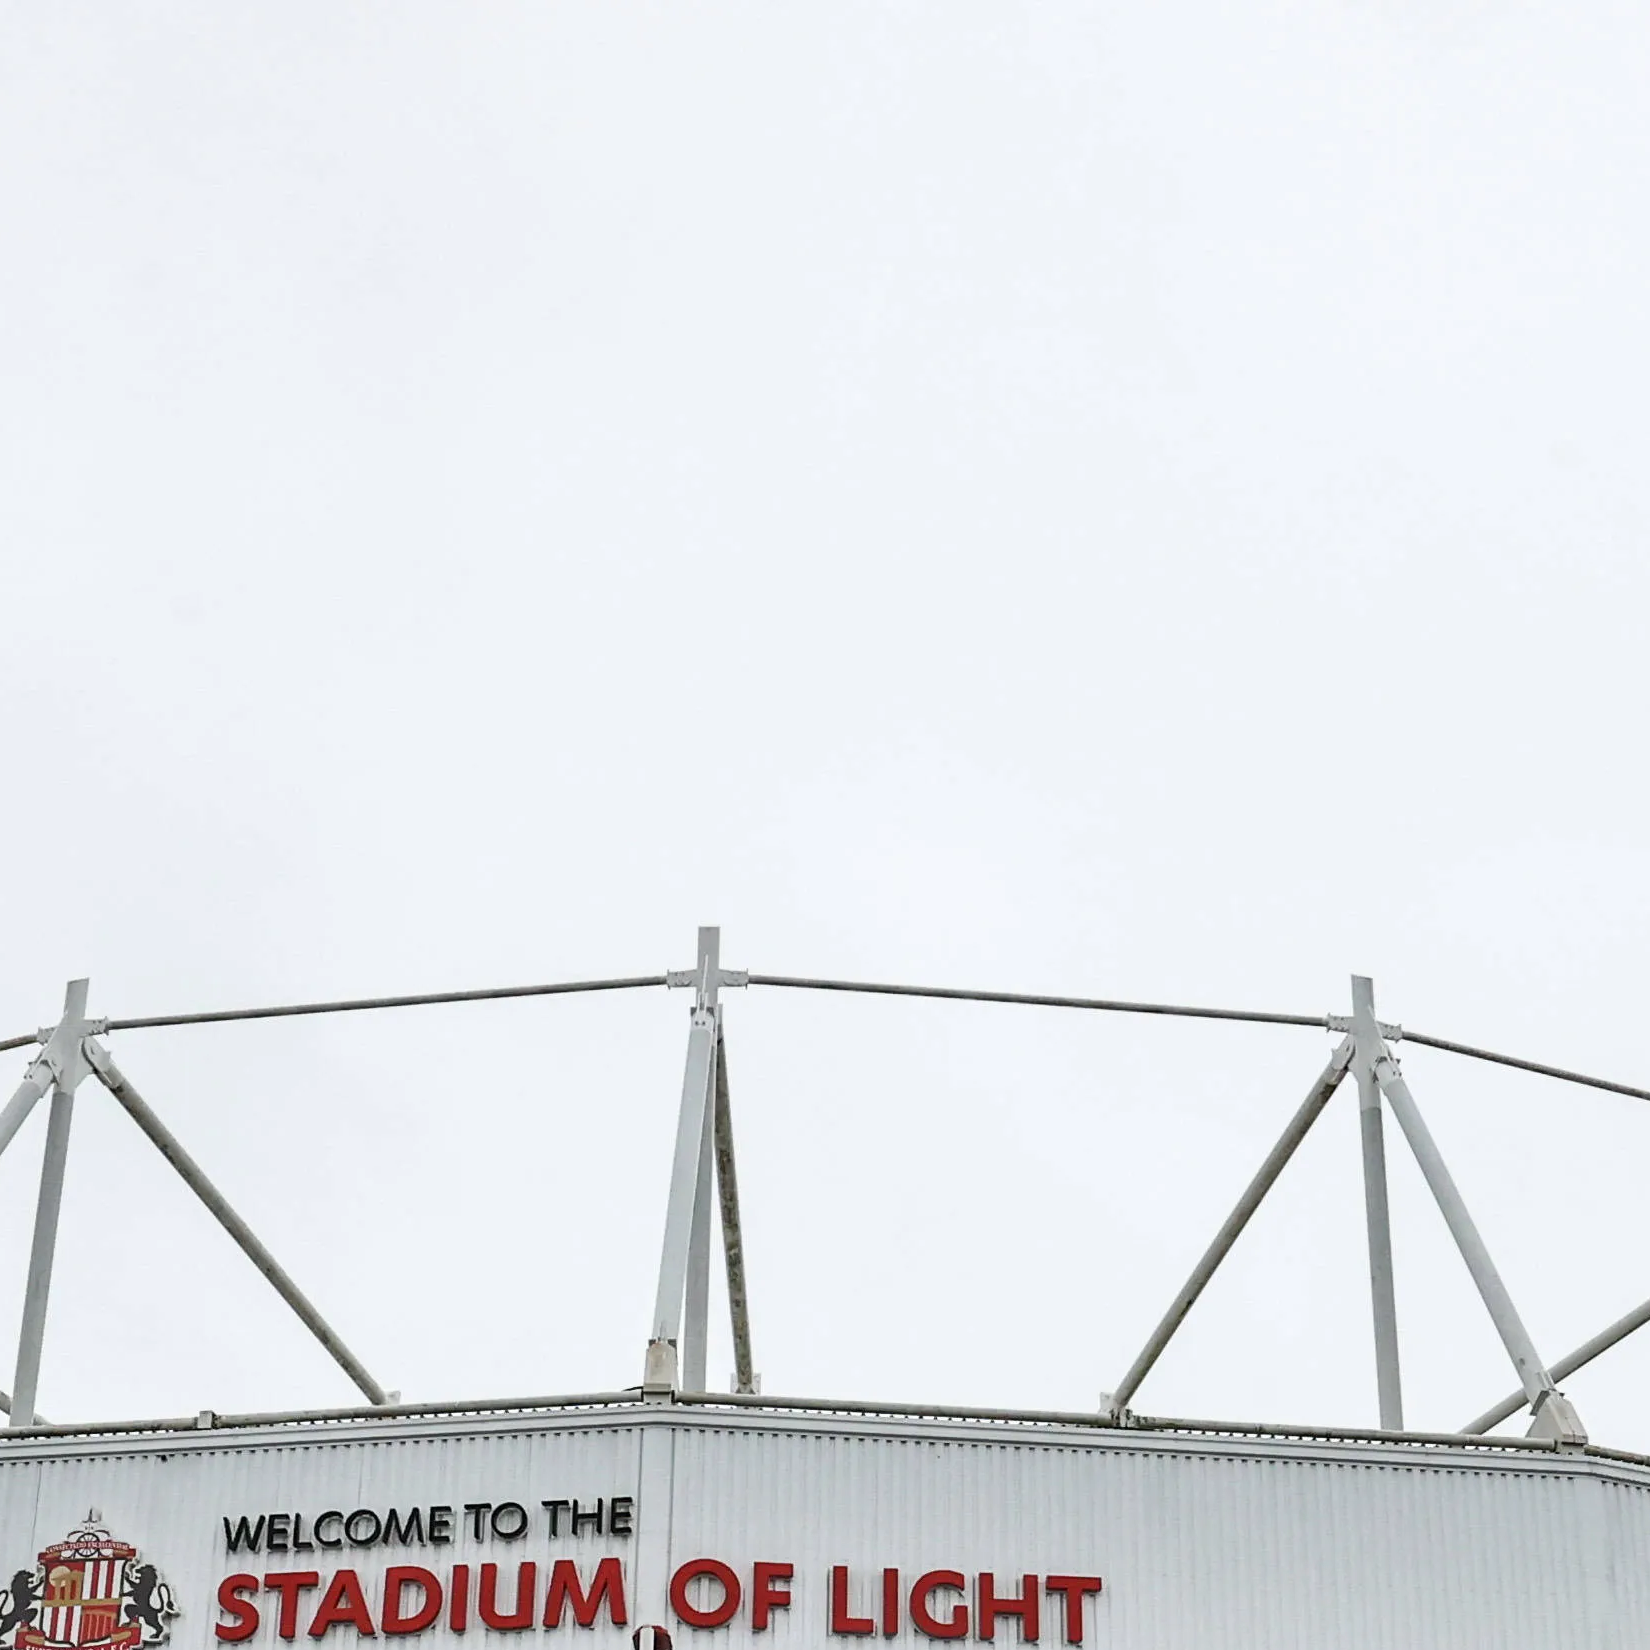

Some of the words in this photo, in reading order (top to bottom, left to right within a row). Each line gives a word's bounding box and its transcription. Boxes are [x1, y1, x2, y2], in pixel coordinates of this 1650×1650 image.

[223, 1506, 452, 1551] WELCOME
[464, 1502, 528, 1541] TO
[541, 1497, 632, 1537] THE
[215, 1558, 628, 1641] STADIUM
[670, 1559, 793, 1630] OF
[833, 1565, 1102, 1643] LIGHT
